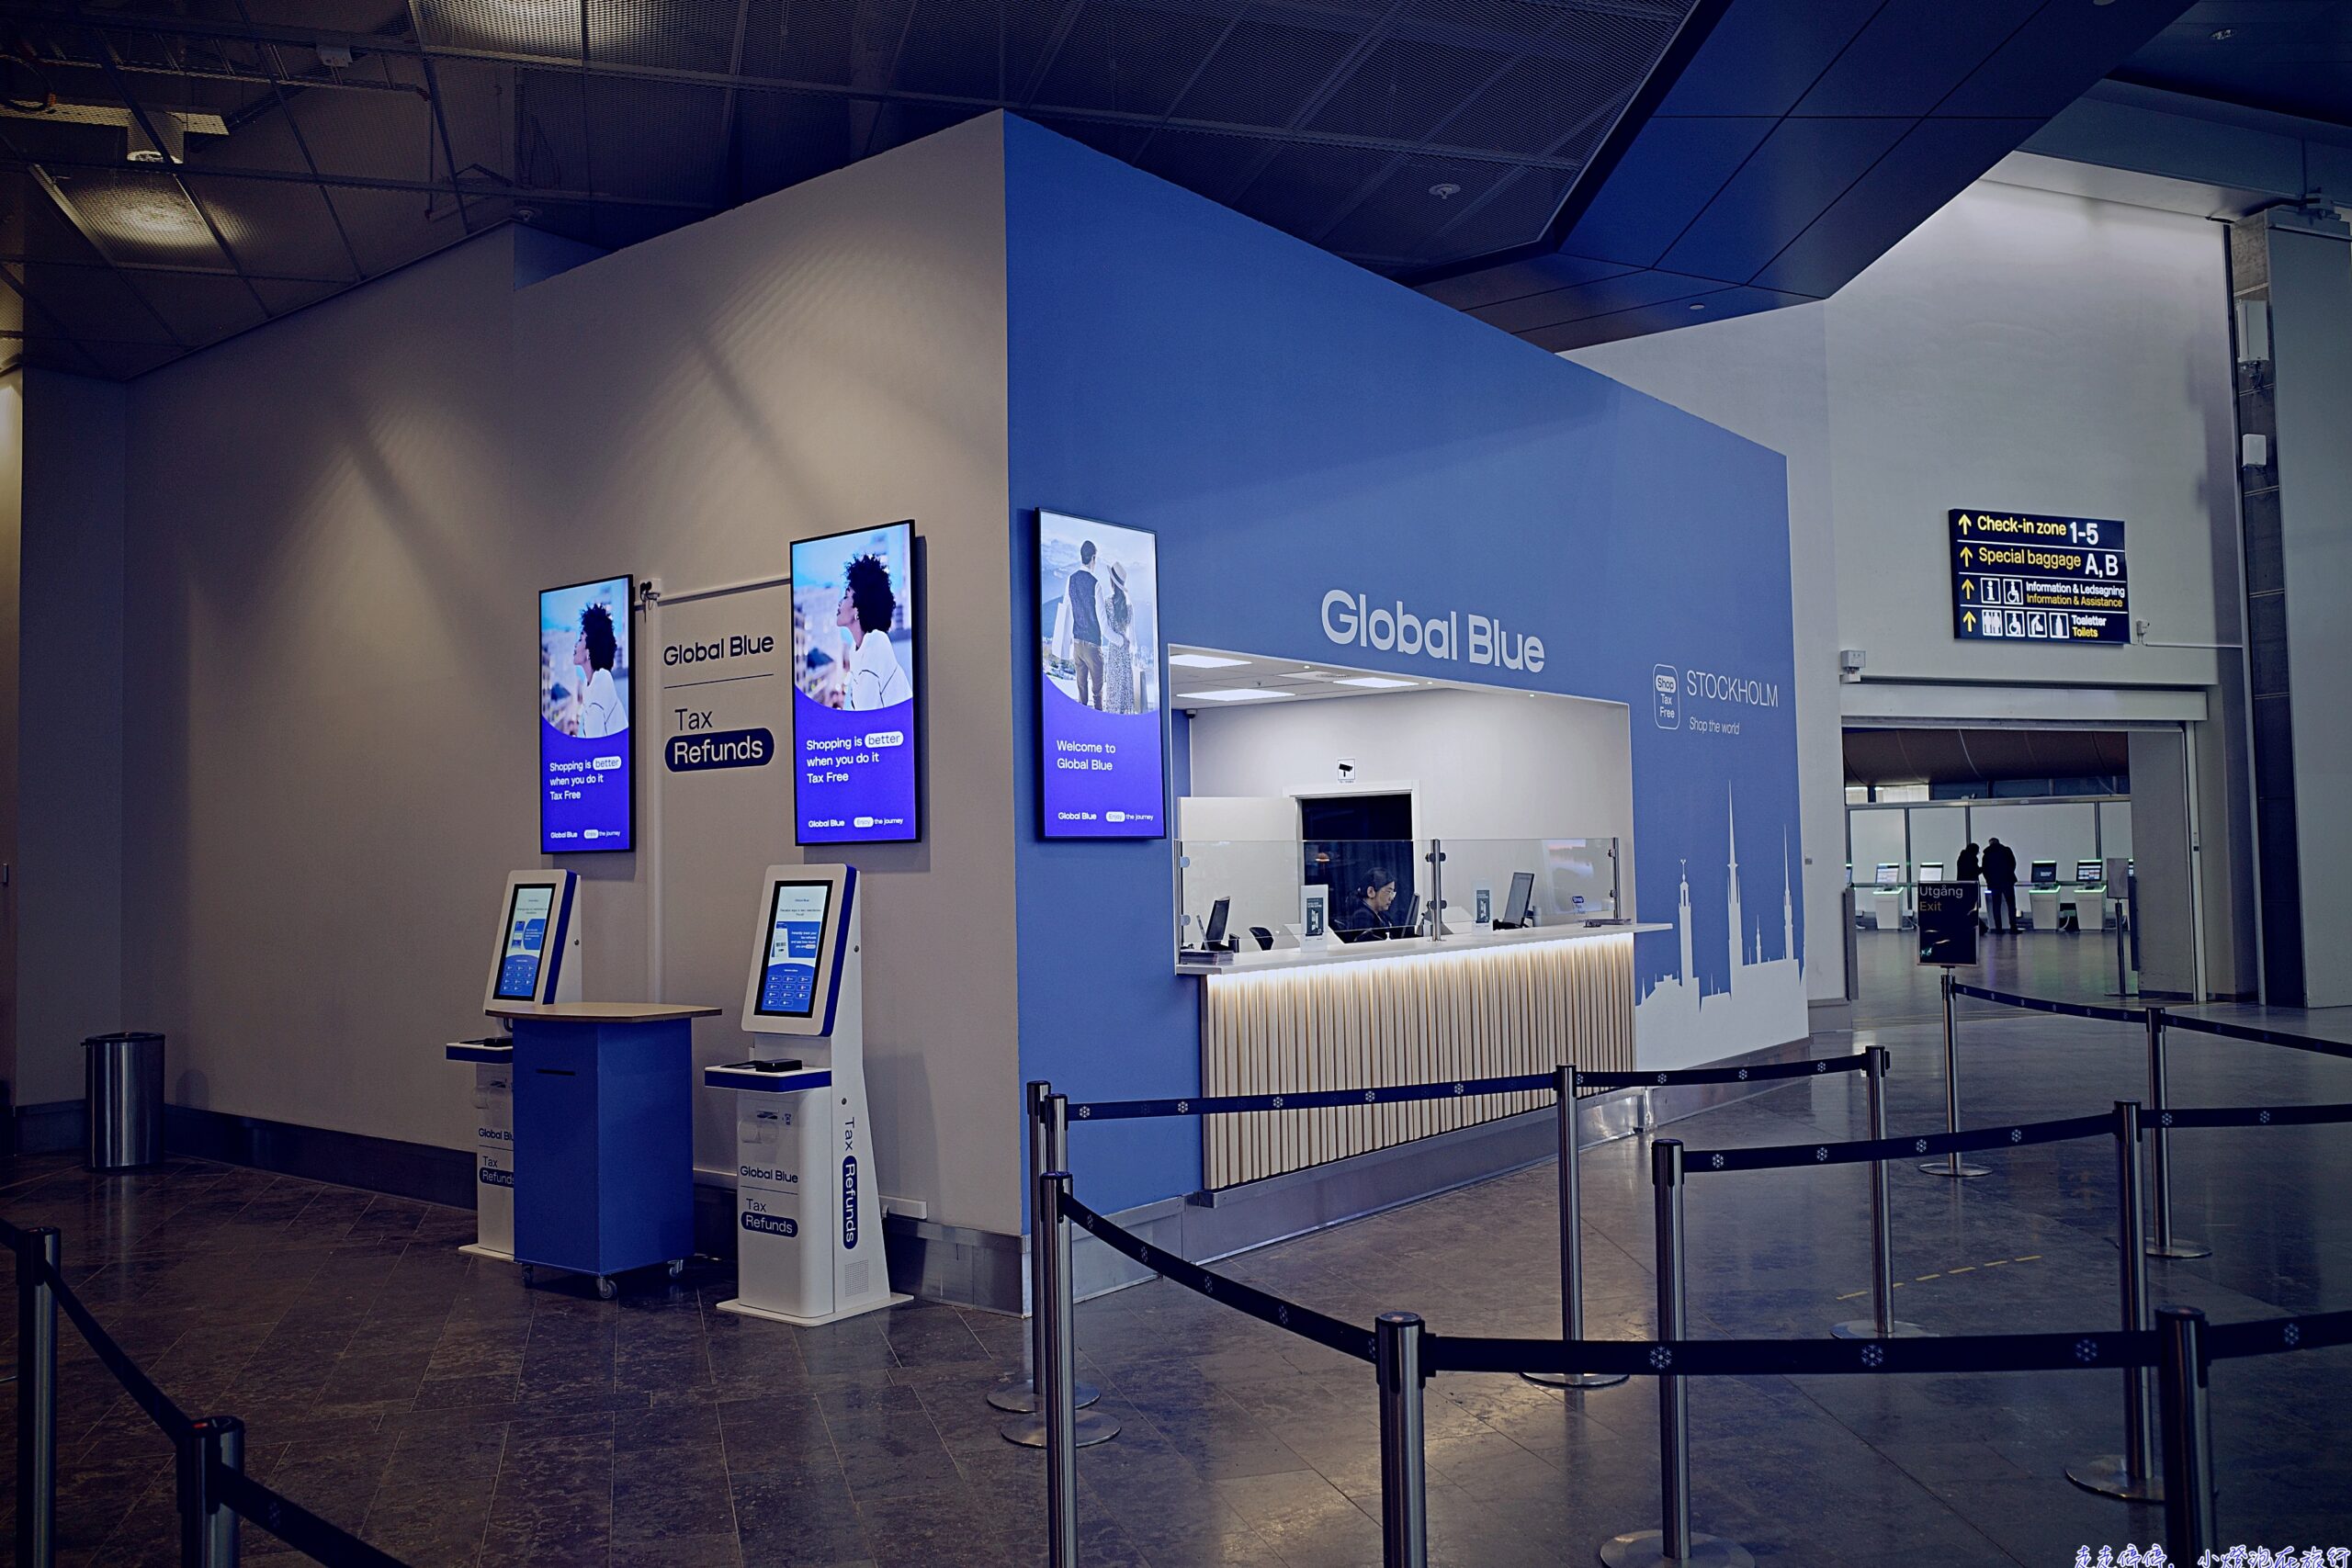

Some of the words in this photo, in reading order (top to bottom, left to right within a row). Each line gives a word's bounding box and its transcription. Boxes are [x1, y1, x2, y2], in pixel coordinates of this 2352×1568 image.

[1977, 514, 2034, 535] Check-in
[2037, 523, 2066, 536] zone
[2069, 522, 2099, 545] 1-5
[1978, 547, 2025, 565] Special
[2027, 549, 2081, 570] baggage
[2026, 581, 2072, 593] Information
[2073, 583, 2079, 593] &
[2080, 584, 2125, 598] Ledsagning
[2027, 593, 2072, 604] Information
[2073, 595, 2080, 605] &
[2081, 596, 2123, 607] Assistance
[2071, 615, 2107, 626] Toaletter
[1321, 589, 1458, 660] Global
[1468, 614, 1545, 673] Blue
[2072, 626, 2098, 637] Toilets
[663, 638, 724, 666] Global
[730, 635, 775, 657] Blue
[1657, 677, 1674, 693] Shop
[1687, 670, 1779, 707] STOCKHOLM
[1660, 694, 1672, 705] Tax
[674, 708, 713, 730] Tax
[1659, 706, 1675, 718] Free
[1690, 716, 1707, 734] Shop
[1709, 719, 1720, 733] the
[1721, 723, 1739, 735] world
[674, 735, 763, 764] Refunds
[807, 738, 852, 751] Shopping
[854, 736, 862, 747] is
[868, 735, 900, 745] better
[1057, 739, 1102, 753] Welcome
[1105, 743, 1116, 753] to
[549, 760, 583, 773] Shopping
[585, 760, 591, 769] is
[595, 758, 619, 768] better
[807, 756, 832, 767] when
[835, 755, 854, 768] you
[856, 753, 869, 763] do
[872, 751, 879, 762] it
[1057, 758, 1089, 770] Global
[1091, 760, 1113, 771] Blue
[549, 776, 570, 785] when
[571, 776, 584, 787] you
[586, 774, 596, 784] do
[597, 773, 604, 783] it
[807, 773, 824, 784] Tax
[826, 772, 849, 782] Free
[549, 791, 563, 800] Tax
[564, 790, 581, 799] Free
[1081, 812, 1097, 820] Blue
[1919, 885, 1963, 898] Utgång
[1919, 901, 1942, 911] Exit
[479, 1128, 503, 1140] Global
[844, 1117, 854, 1151] Tax
[482, 1156, 498, 1168] Tax
[740, 1166, 773, 1180] Global
[775, 1170, 798, 1183] Blue
[746, 1198, 767, 1213] Tax
[845, 1163, 856, 1243] Refunds
[745, 1215, 793, 1234] Refunds
